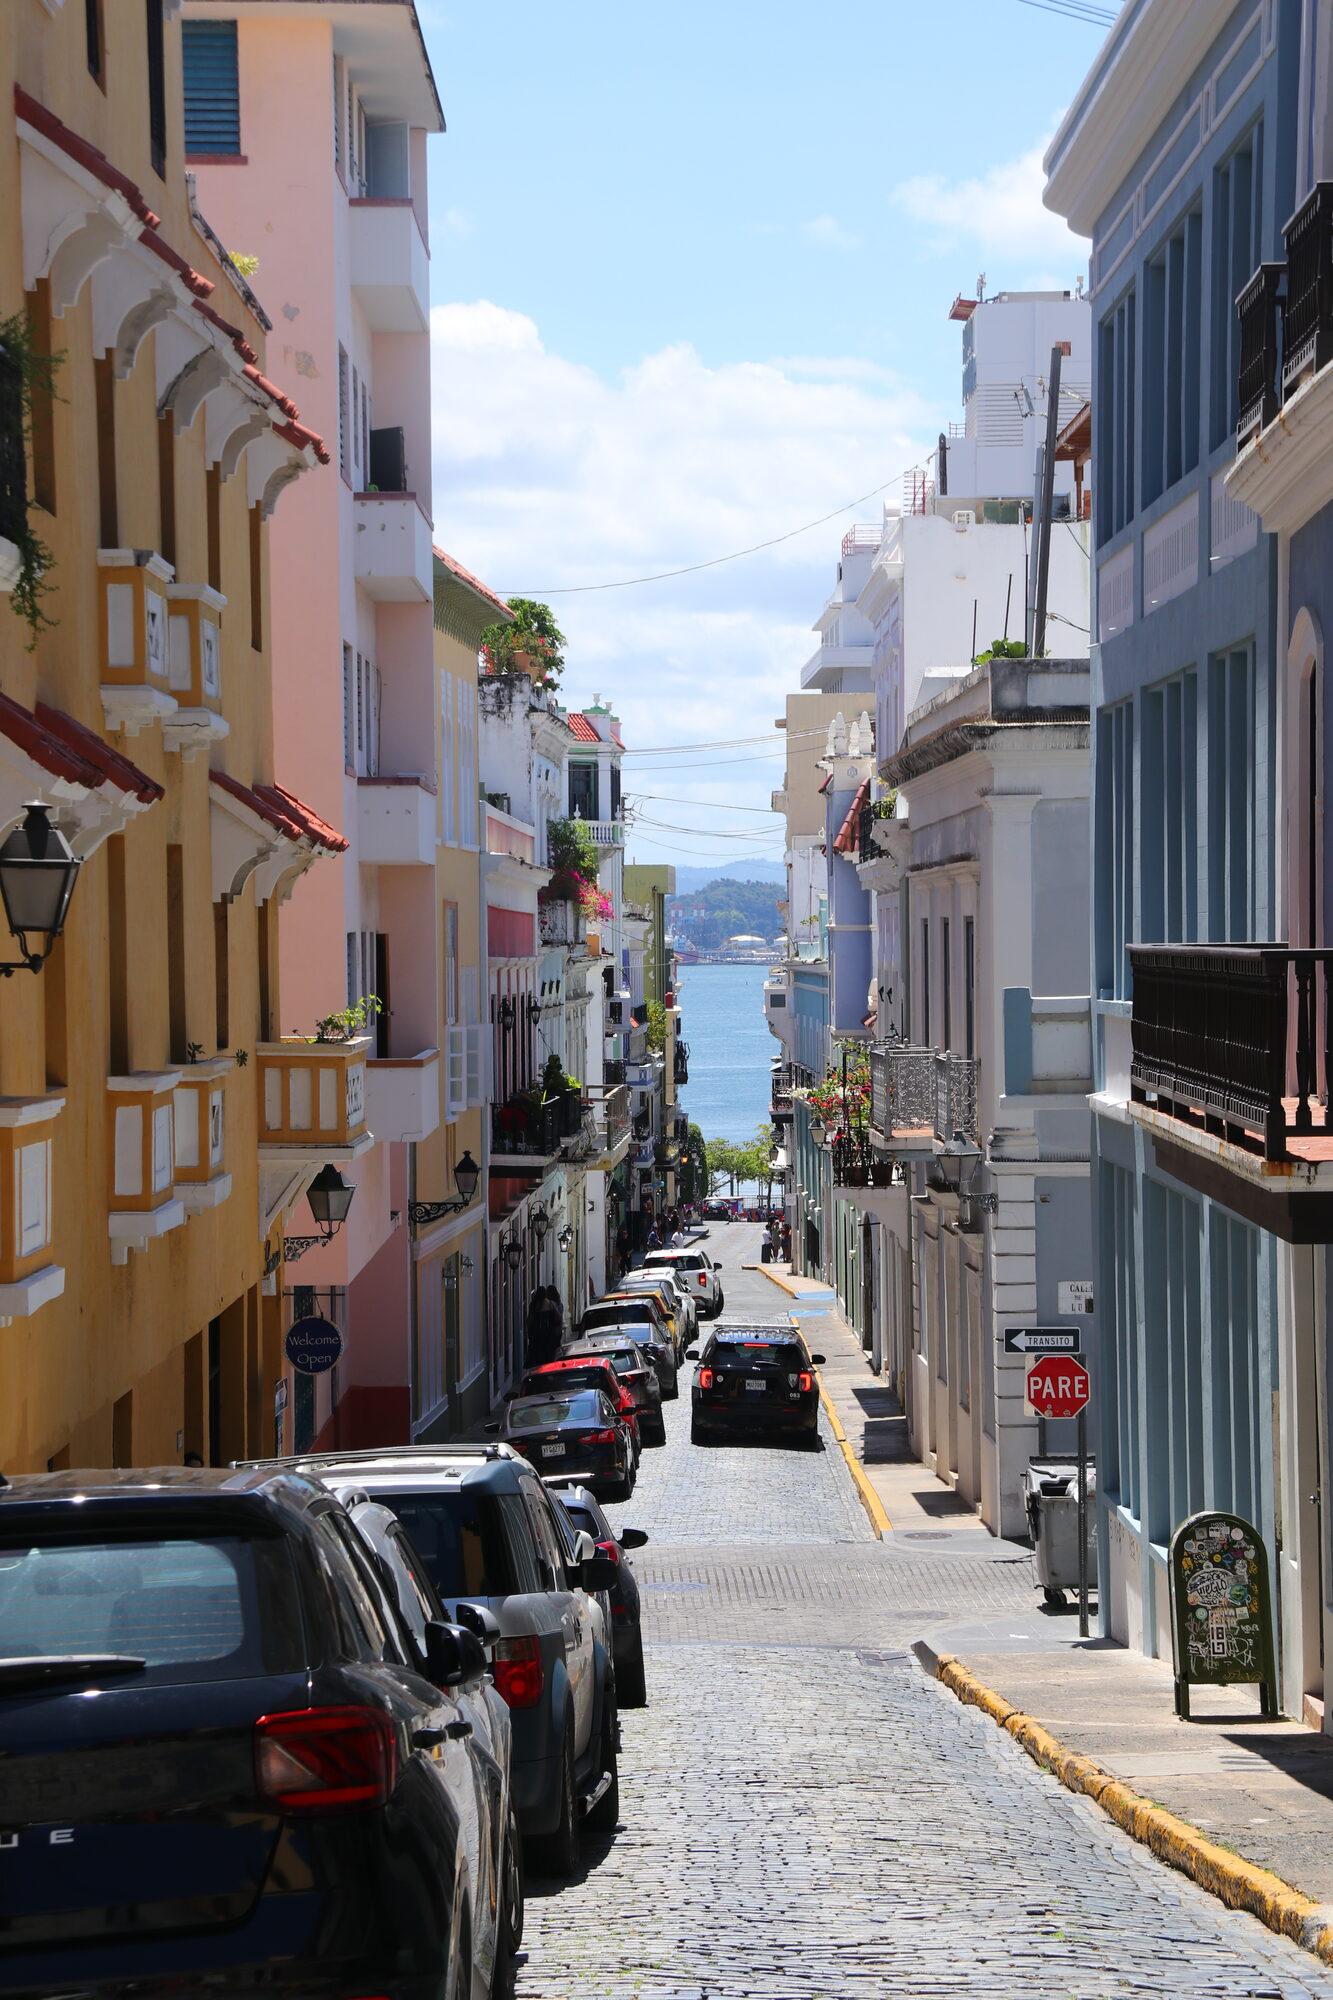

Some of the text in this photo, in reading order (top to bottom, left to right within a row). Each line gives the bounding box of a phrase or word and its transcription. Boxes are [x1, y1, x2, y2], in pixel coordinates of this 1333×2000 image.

[289, 1332, 339, 1346] Welcome
[1028, 1337, 1070, 1345] TRANSITO
[297, 1353, 331, 1369] Open
[1030, 1375, 1087, 1399] PARE
